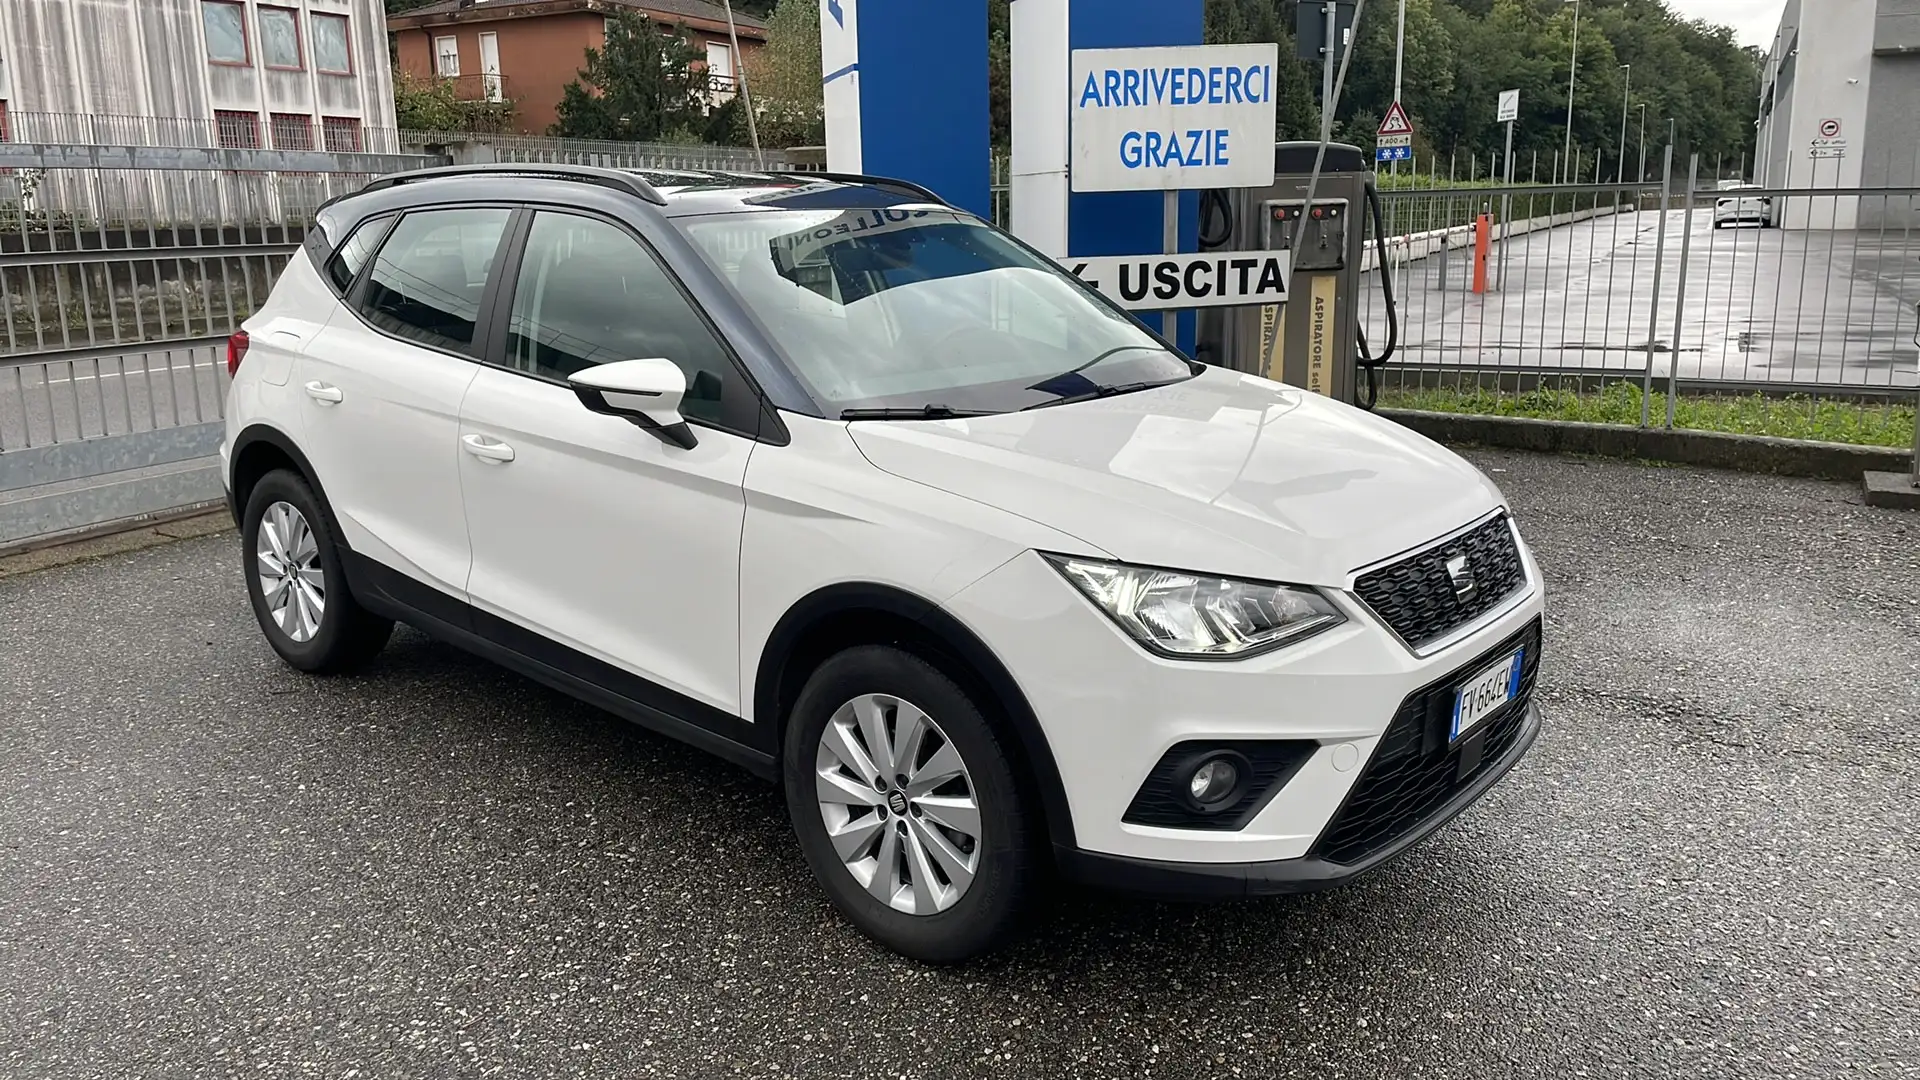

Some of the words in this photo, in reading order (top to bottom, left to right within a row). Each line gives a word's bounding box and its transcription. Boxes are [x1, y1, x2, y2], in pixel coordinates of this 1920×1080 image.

[1080, 65, 1270, 107] ARRIVEDERCI
[1120, 129, 1229, 168] GRAZIE
[1119, 258, 1286, 301] USCITA
[1313, 296, 1325, 369] ASPIRATORE
